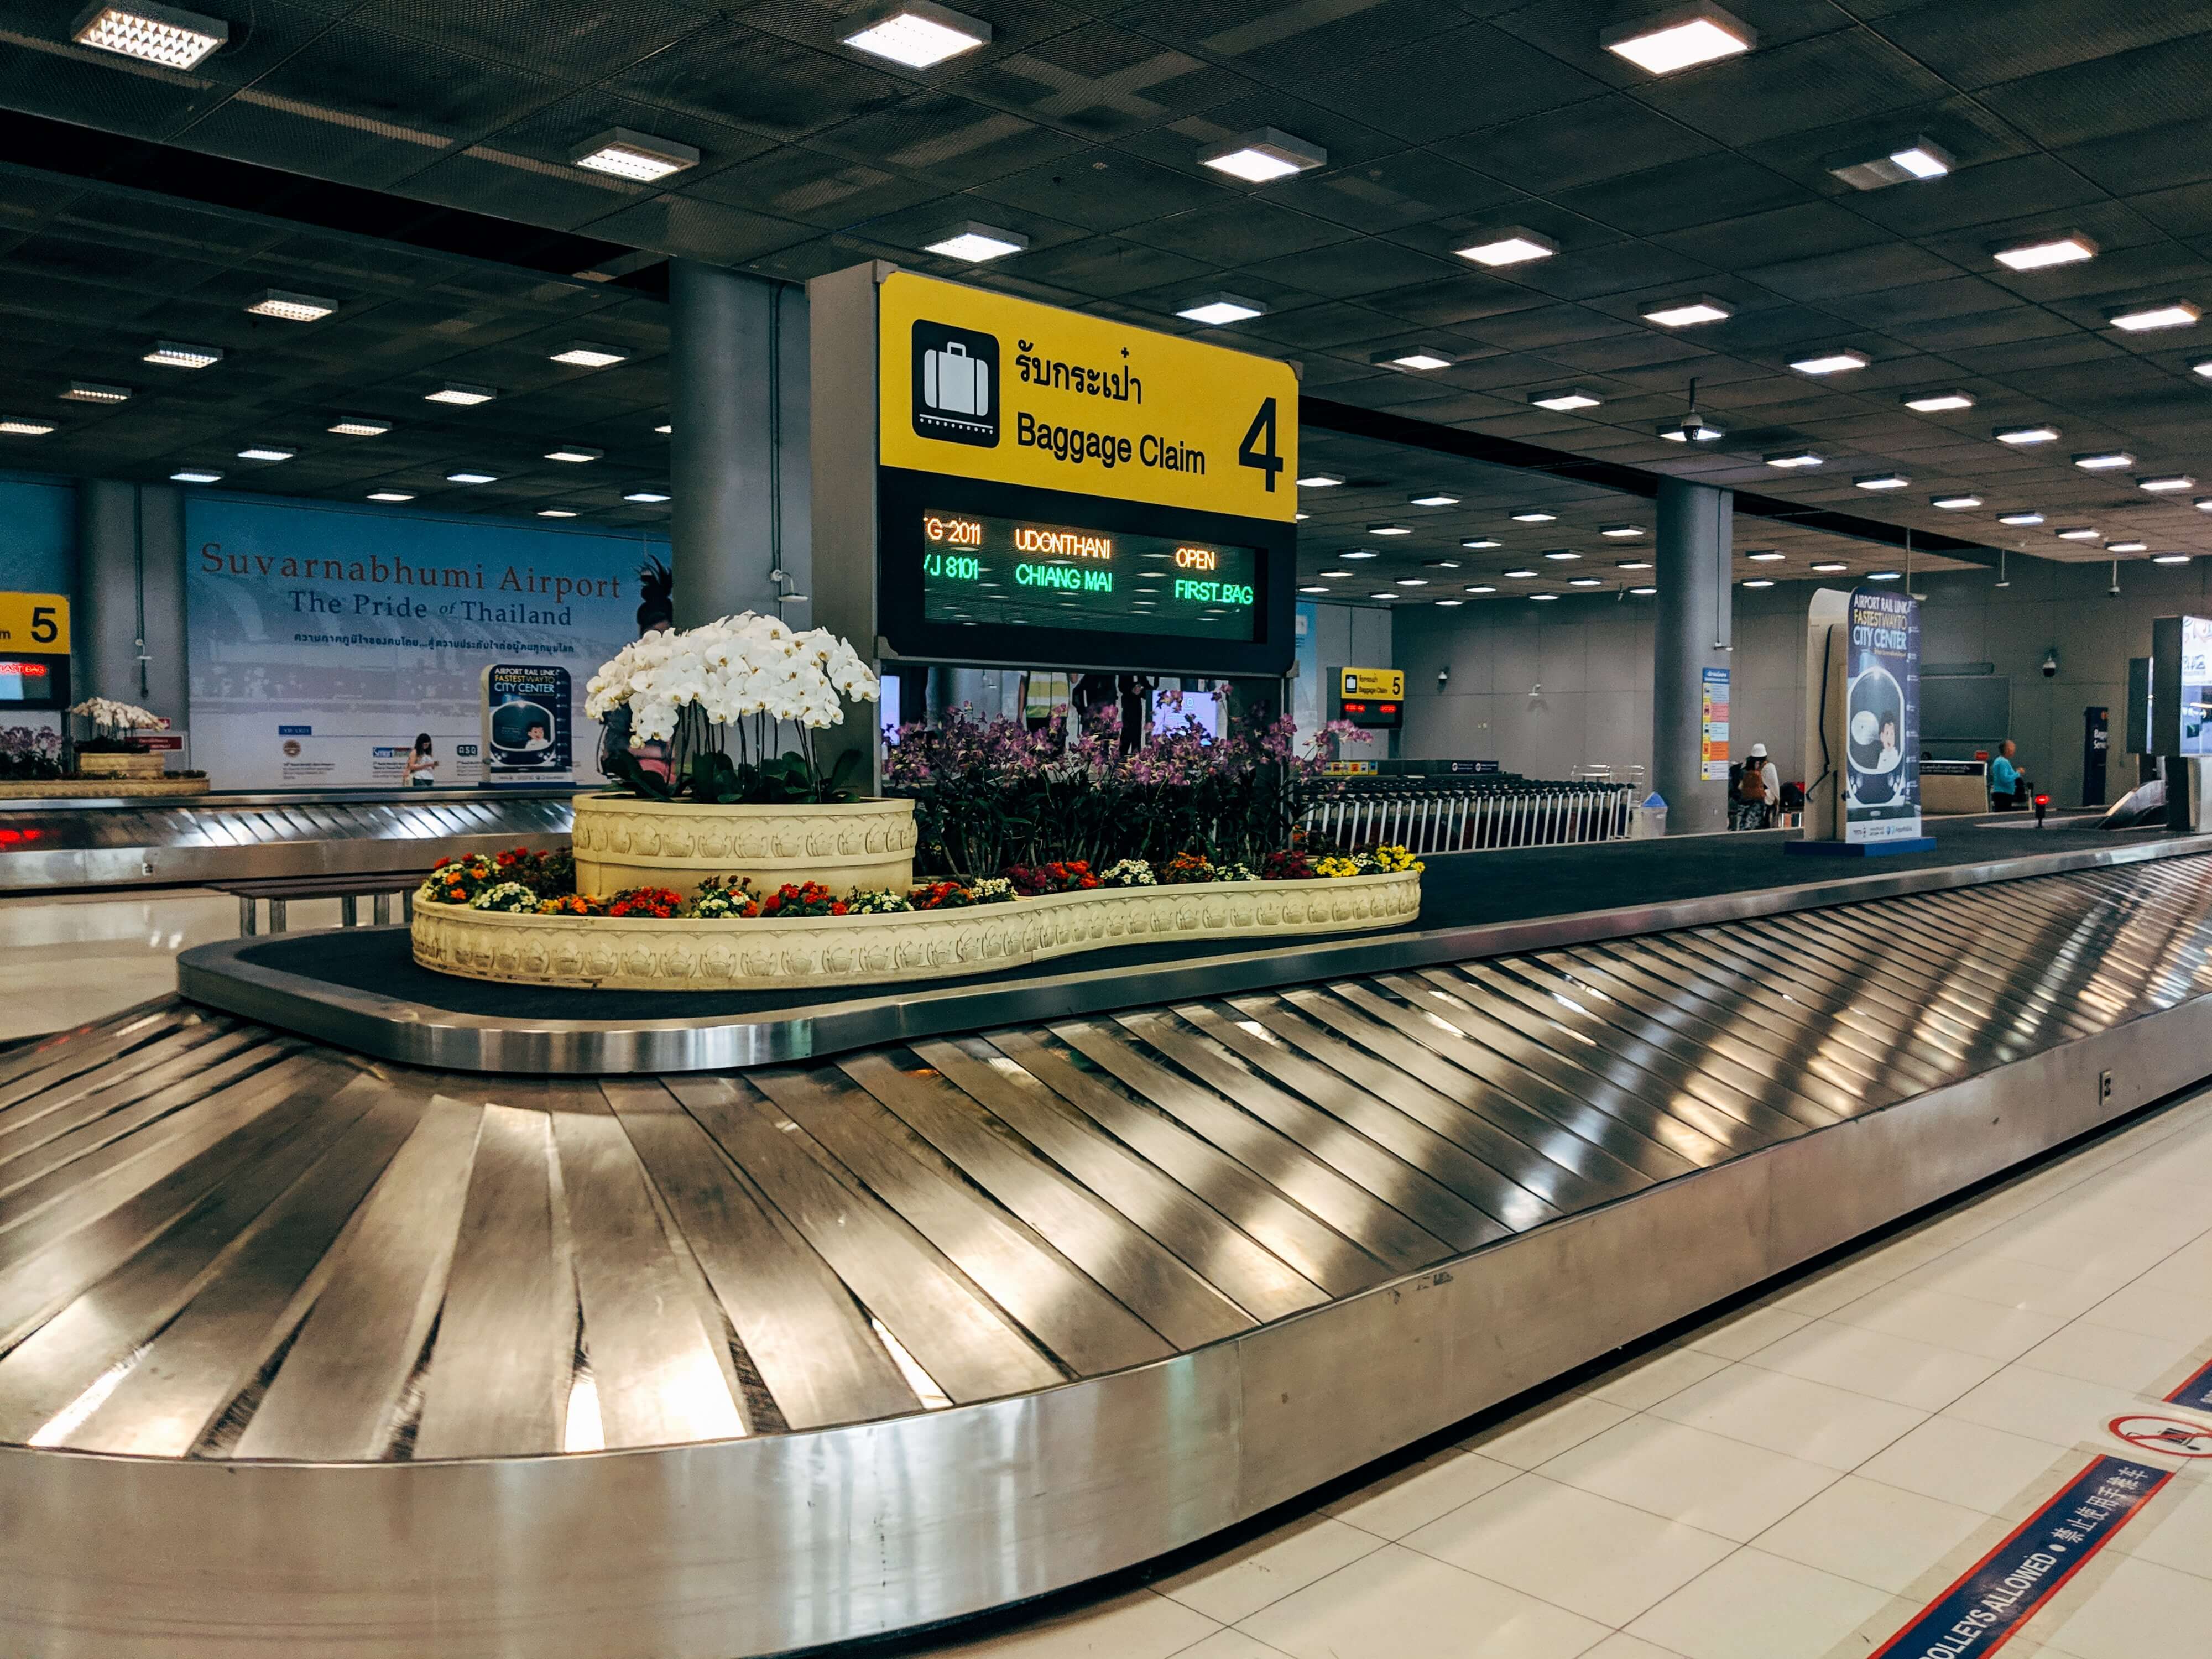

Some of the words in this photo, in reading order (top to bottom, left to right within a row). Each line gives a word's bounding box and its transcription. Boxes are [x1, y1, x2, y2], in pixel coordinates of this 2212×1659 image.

[1016, 339, 1142, 404] รับกระเป๋า
[1018, 411, 1132, 468] Baggage
[1140, 434, 1206, 474] Claim
[1238, 397, 1284, 493] 4
[923, 517, 943, 540] G
[948, 520, 981, 545] 2011
[1015, 528, 1110, 559] UDONTHANI
[946, 556, 978, 580] 8101
[1176, 547, 1215, 570] OPEN
[201, 542, 484, 589] Suvarnabhumi
[499, 566, 620, 604] Airport
[1016, 564, 1081, 589] CHIANG
[1084, 570, 1112, 592] MAI
[1175, 579, 1220, 602] FIRST
[1222, 584, 1254, 604] BAG
[1854, 594, 1880, 610] AIRPORT
[1881, 598, 1893, 613] RAIL
[1893, 600, 1908, 615] LINK
[289, 590, 342, 613] The
[353, 594, 427, 618] Pride
[439, 601, 457, 614] of
[461, 601, 572, 626] Thailand
[1854, 609, 1884, 627] FASTEST
[1883, 612, 1898, 628] WAY
[1897, 614, 1907, 630] TO
[31, 607, 58, 644] 5
[1853, 625, 1874, 647] CITY
[1874, 628, 1907, 650] CENTER
[25, 665, 45, 674] BAG
[495, 675, 525, 683] FASTEST
[494, 682, 517, 692] CITY
[518, 683, 555, 693] CENTER
[1392, 676, 1400, 695] 5
[2050, 1467, 2149, 1543] 禁止使用手推车
[1918, 1608, 1997, 1659] OLLEYS
[1981, 1552, 2057, 1613] ALLOWED
